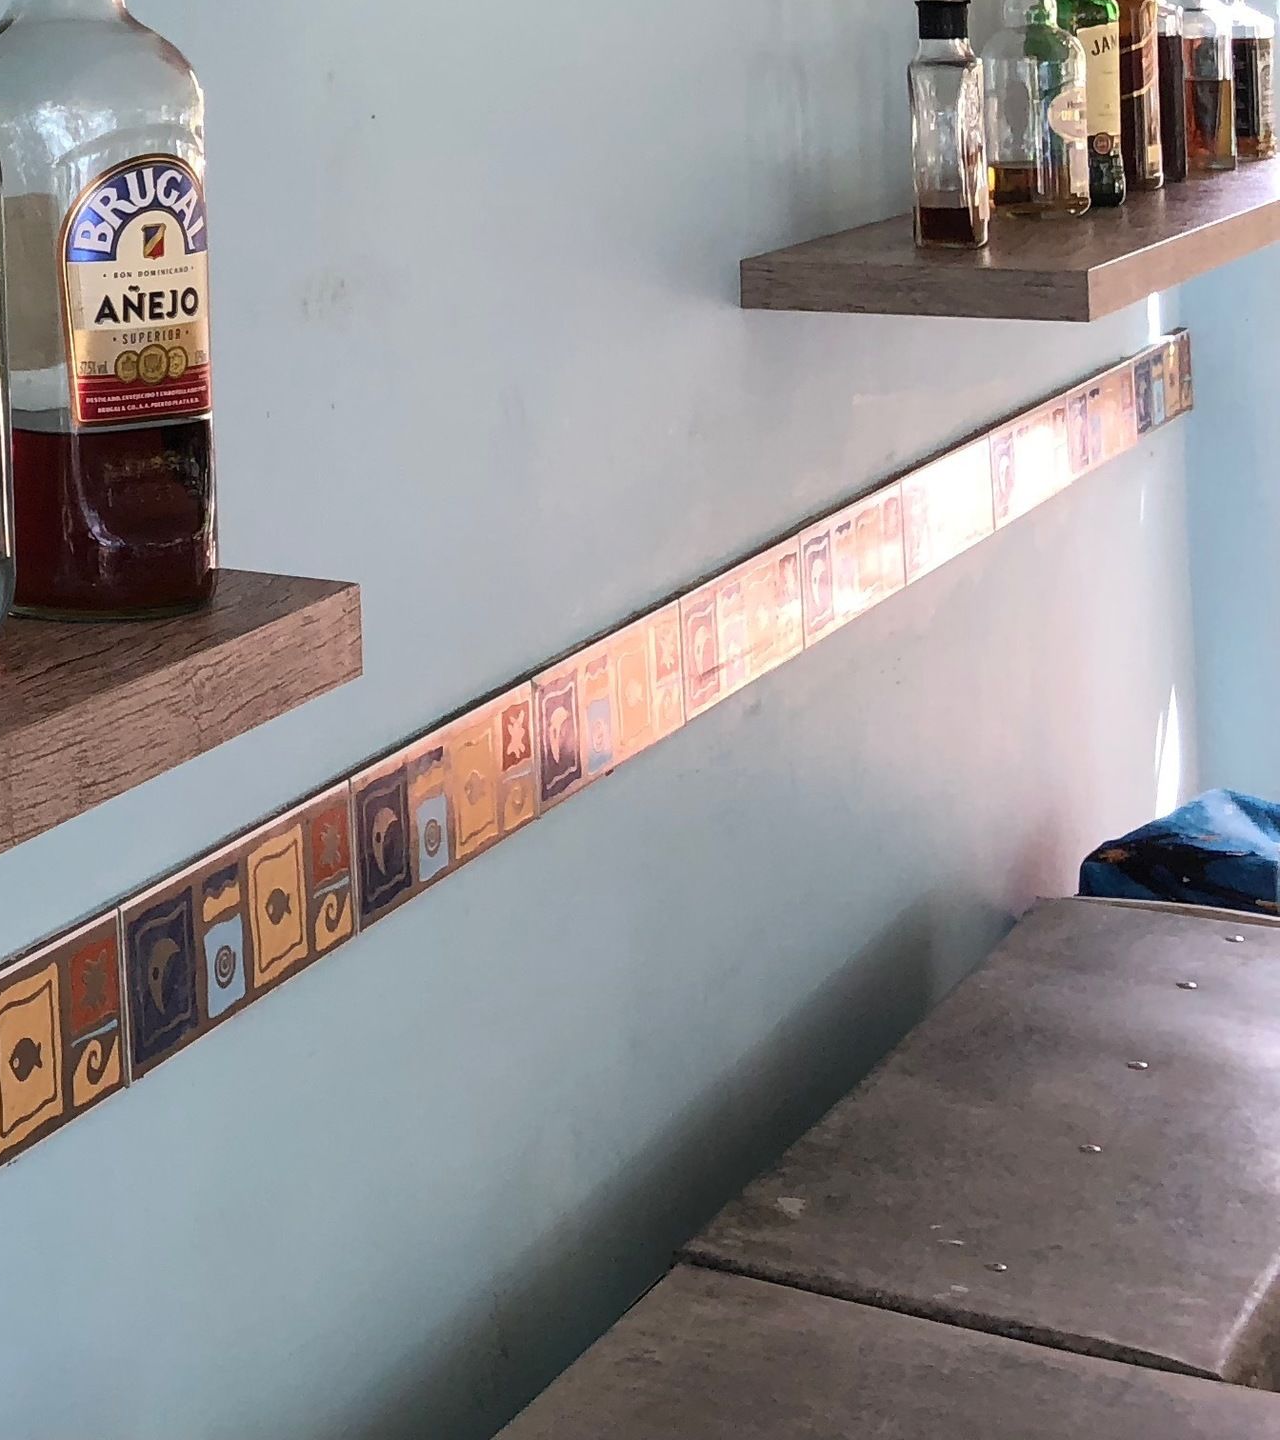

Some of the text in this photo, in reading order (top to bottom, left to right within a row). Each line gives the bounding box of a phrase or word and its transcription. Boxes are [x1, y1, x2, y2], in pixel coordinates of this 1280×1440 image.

[73, 166, 205, 254] BRUGAL
[137, 267, 189, 278] DOMINICANO
[94, 285, 199, 324] AÑEJO
[122, 328, 181, 345] SUPERIOR
